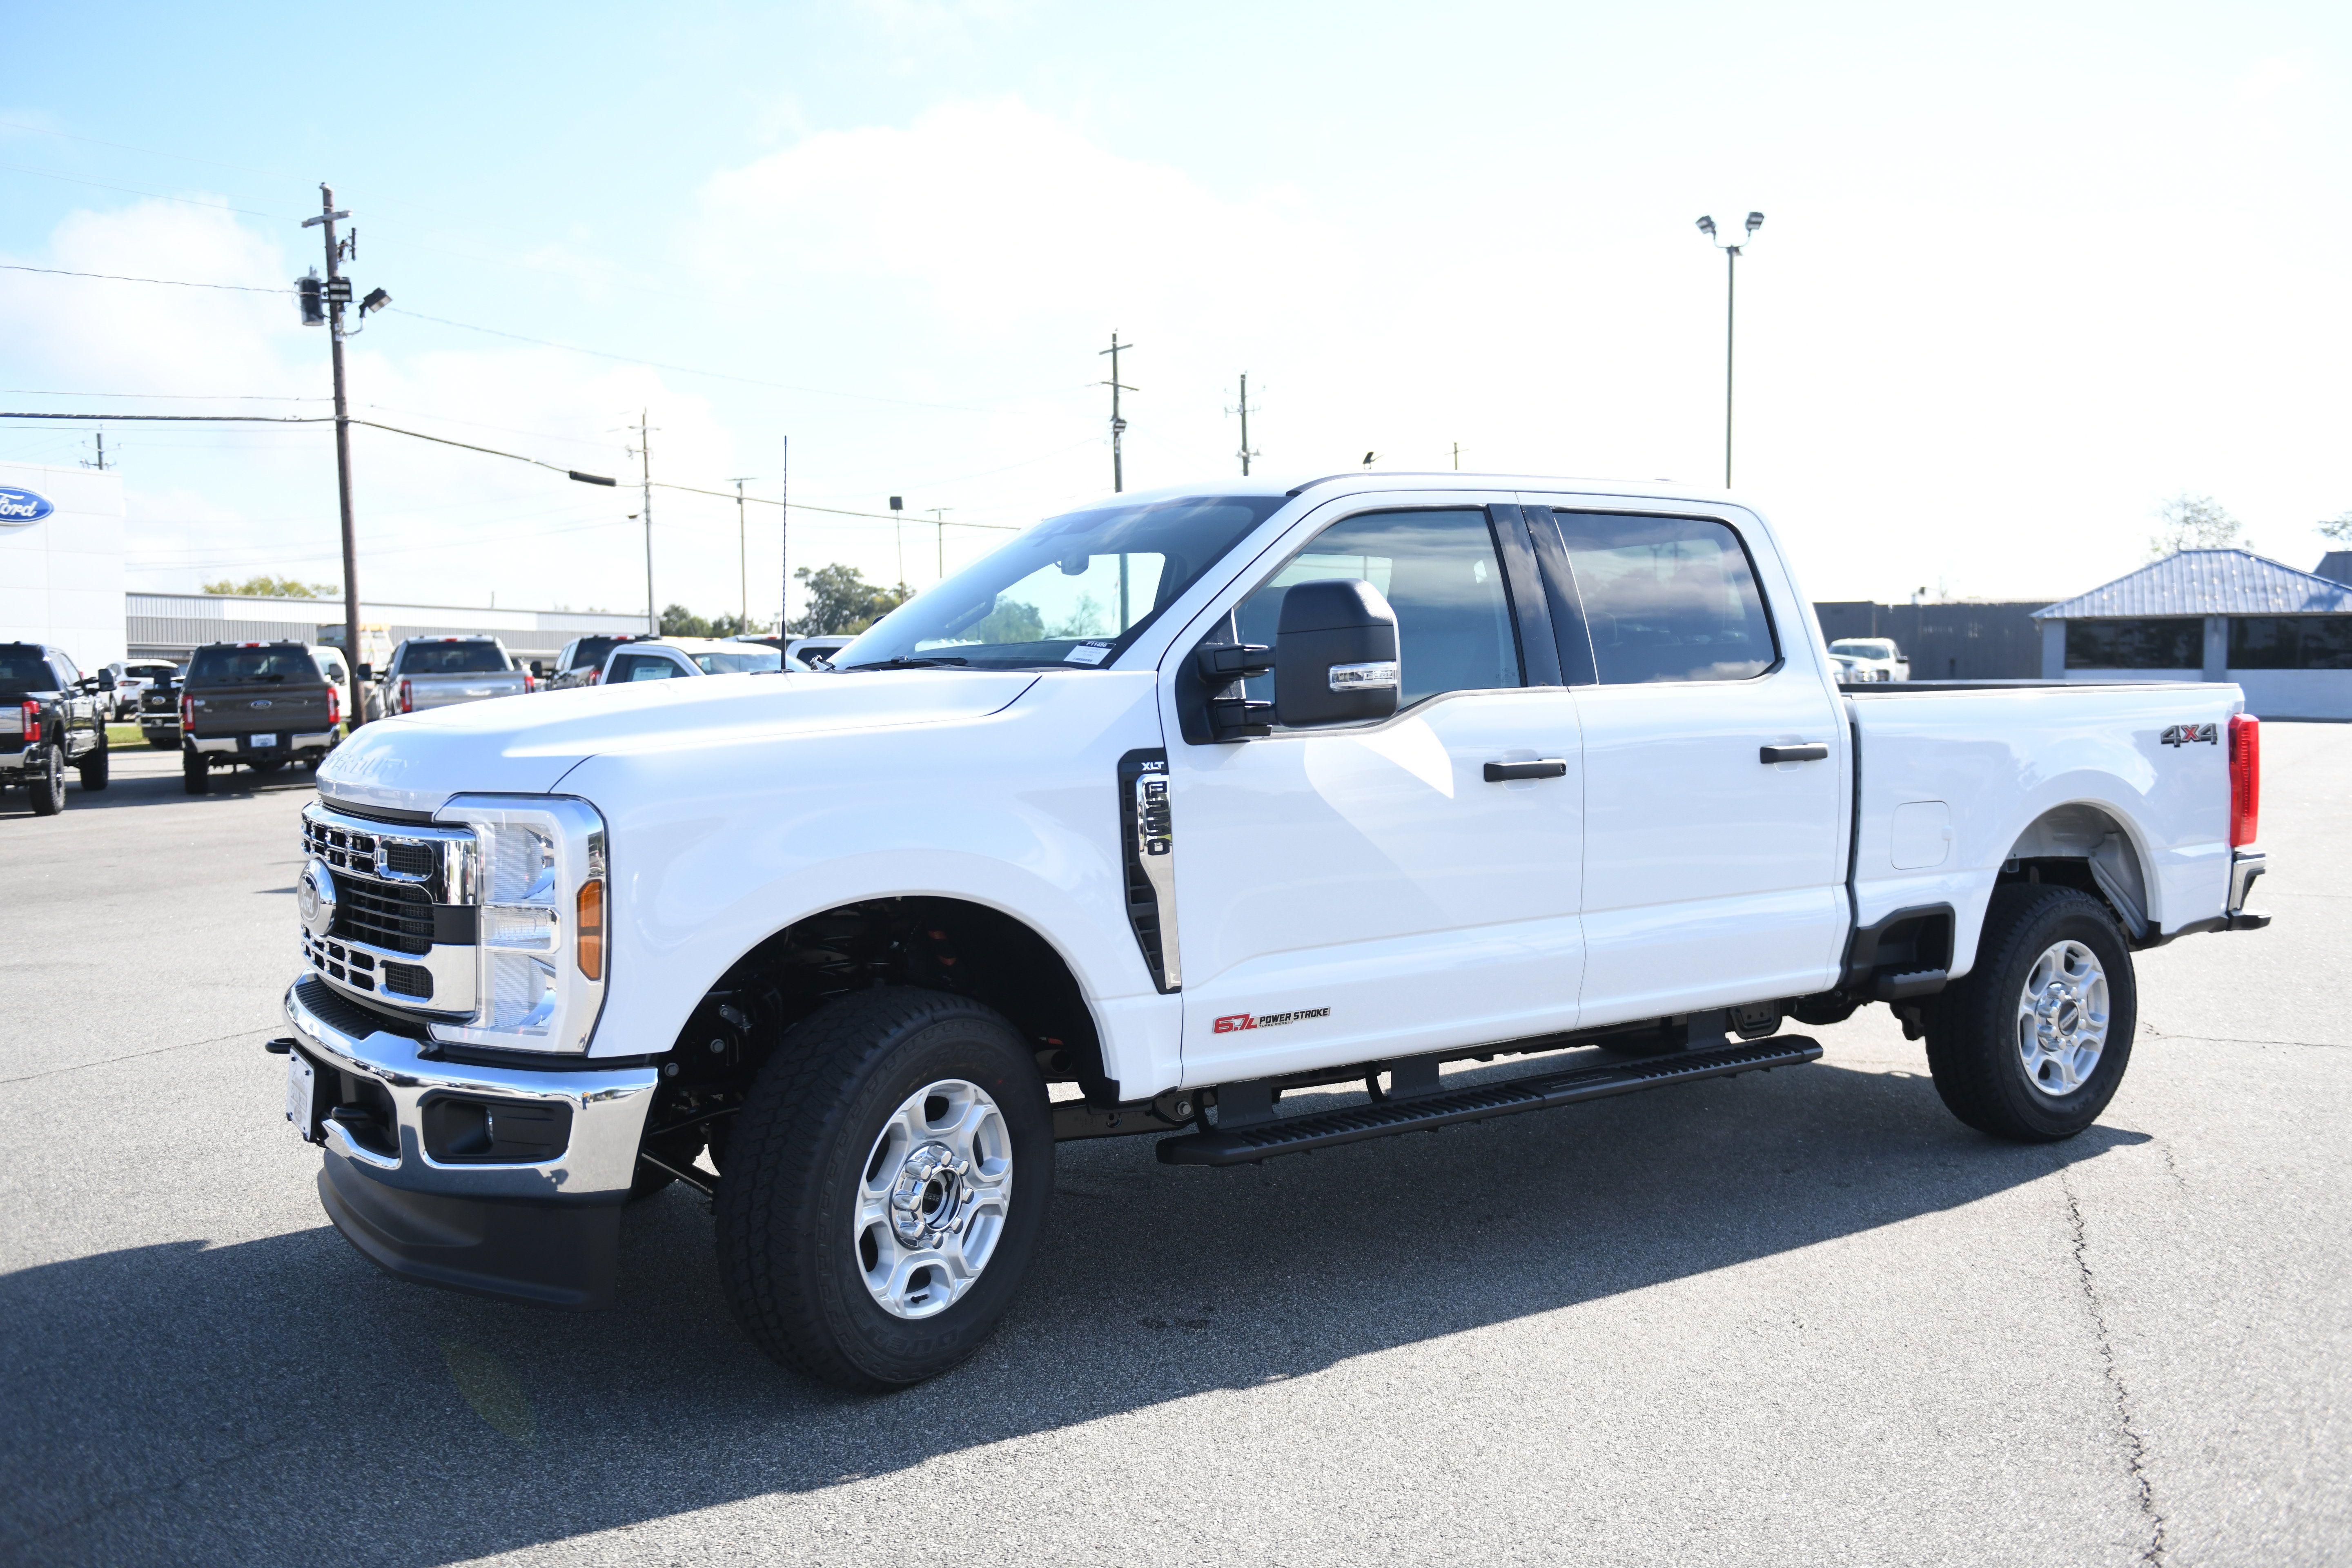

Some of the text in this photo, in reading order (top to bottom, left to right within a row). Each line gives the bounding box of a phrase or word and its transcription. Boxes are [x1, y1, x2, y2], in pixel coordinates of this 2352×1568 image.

[321, 751, 354, 773] UPER
[1141, 762, 1164, 771] XLT
[1145, 781, 1170, 855] F250
[301, 879, 315, 914] Ford
[1214, 1008, 1329, 1033] 6.7L POWER STROKE
